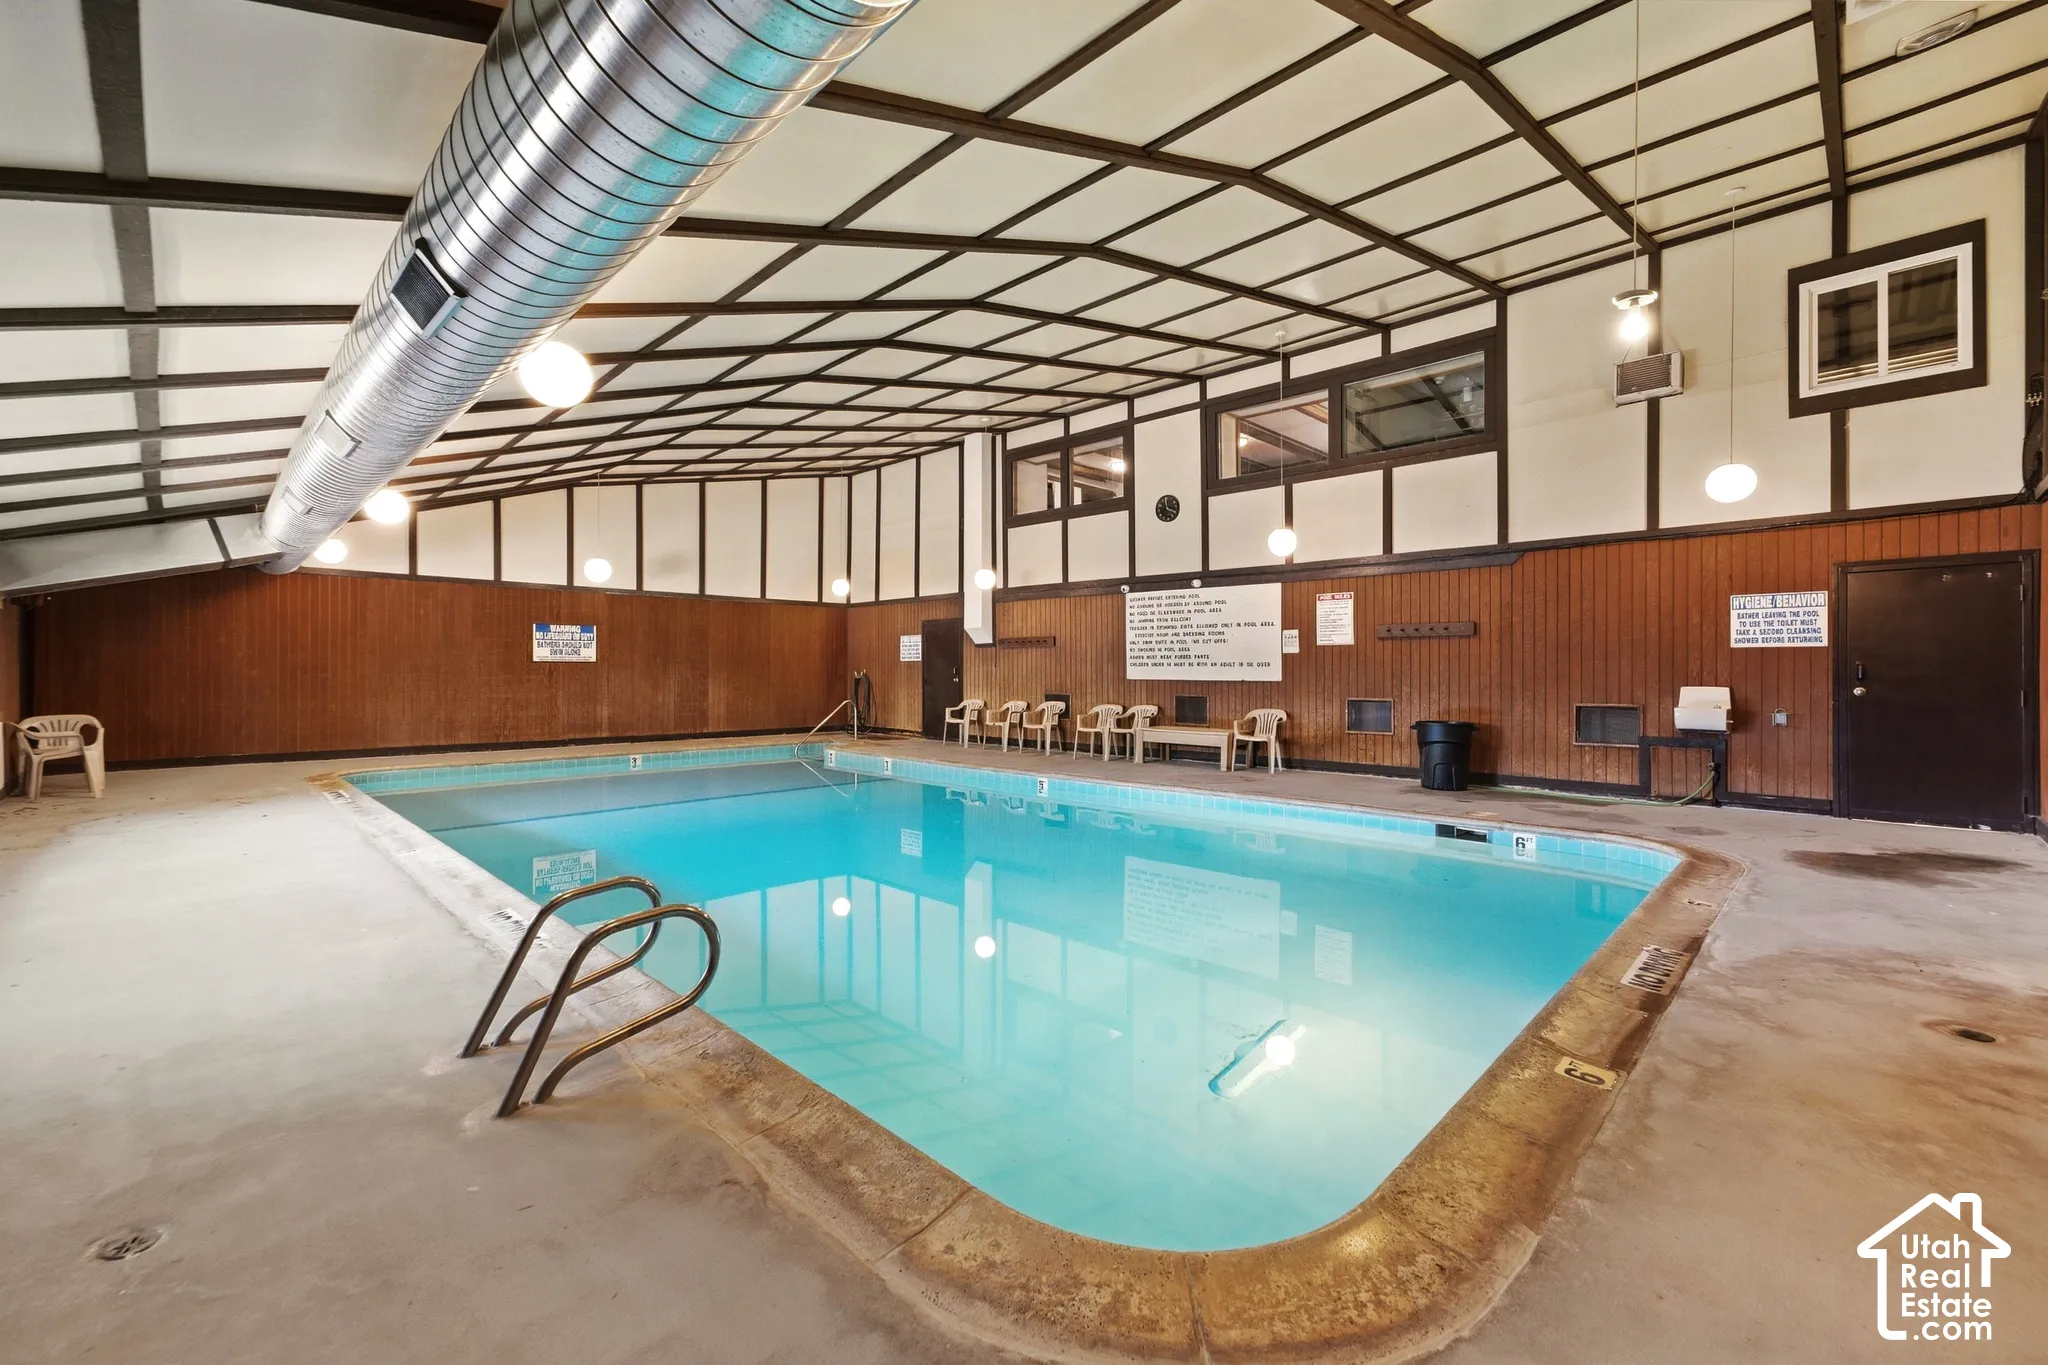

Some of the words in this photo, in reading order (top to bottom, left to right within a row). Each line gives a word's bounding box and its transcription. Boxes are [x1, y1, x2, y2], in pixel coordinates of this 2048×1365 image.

[1733, 593, 1824, 609] HYGIENE/BEHAVIOR
[1762, 611, 1787, 619] LEAVING
[550, 624, 581, 632] WARNING
[561, 641, 582, 649] SHOULD
[1761, 636, 1785, 644] BEFORE
[1638, 947, 1684, 978] DIVING
[1628, 973, 1666, 992] NO
[1564, 1067, 1605, 1085] 6
